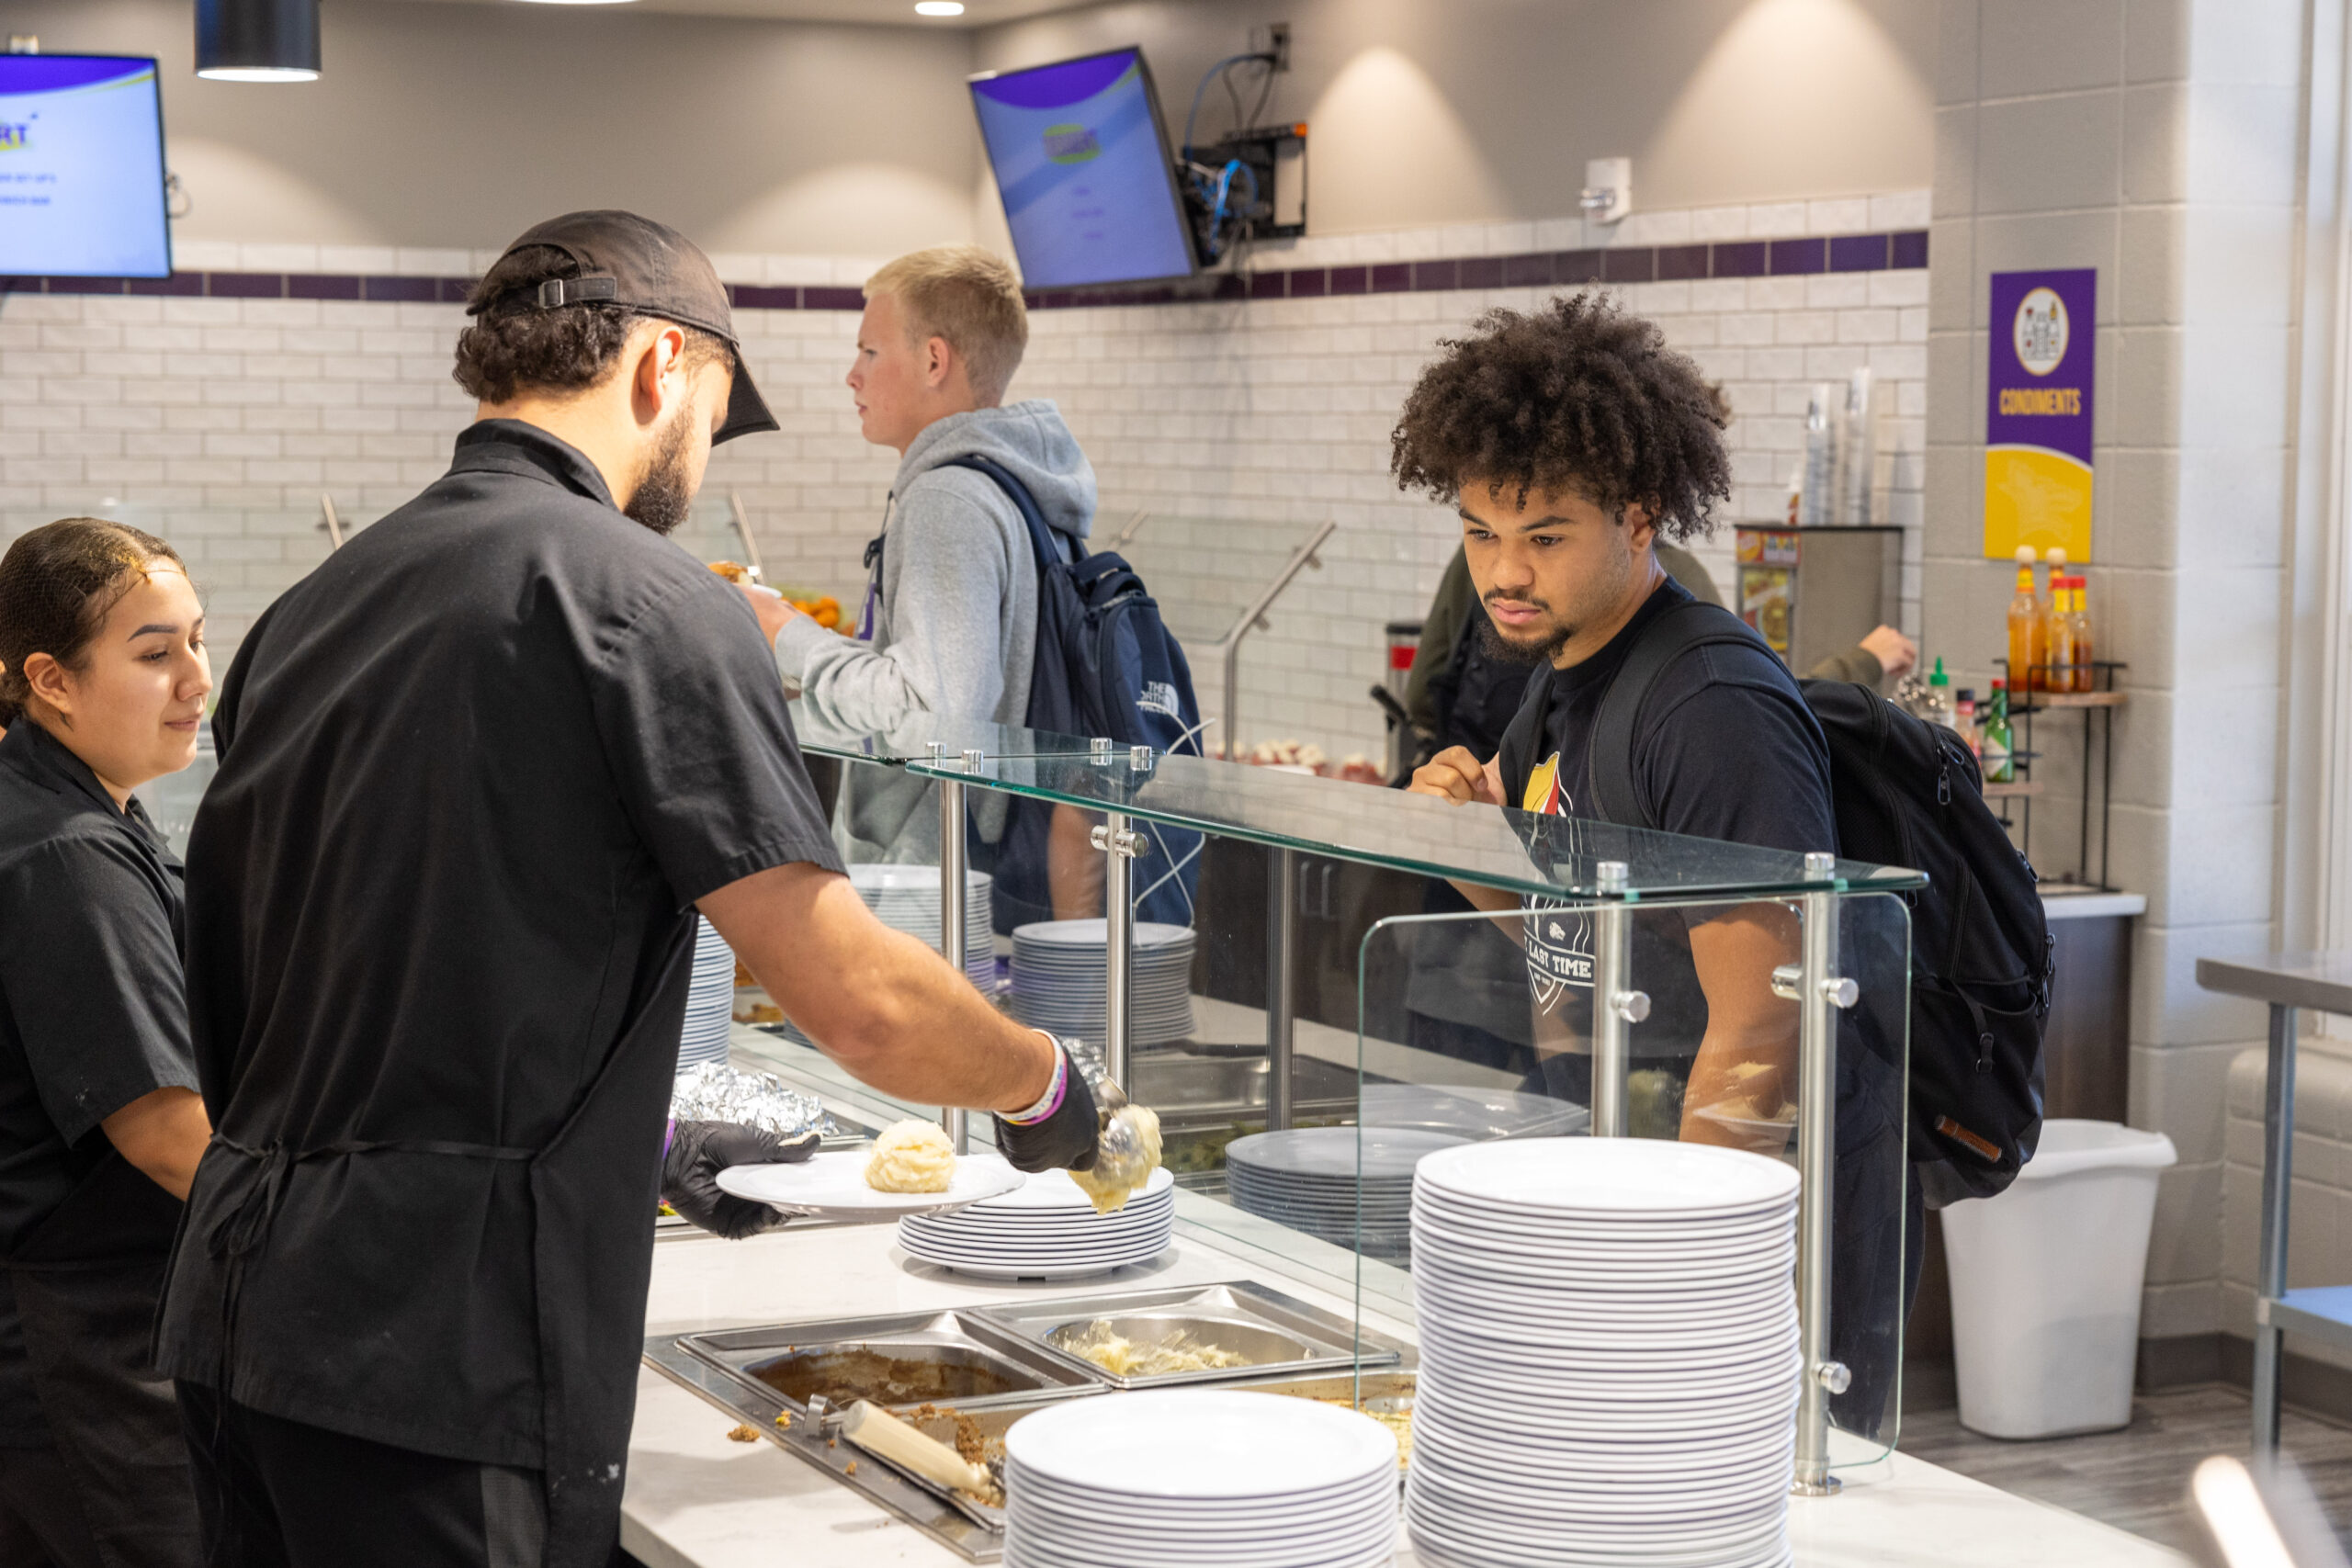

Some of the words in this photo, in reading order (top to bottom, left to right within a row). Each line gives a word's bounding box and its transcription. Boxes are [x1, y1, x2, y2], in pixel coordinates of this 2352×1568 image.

[1999, 388, 2081, 416] CONDIMENTS
[1529, 939, 1549, 968] LAST
[1552, 955, 1592, 978] TIME
